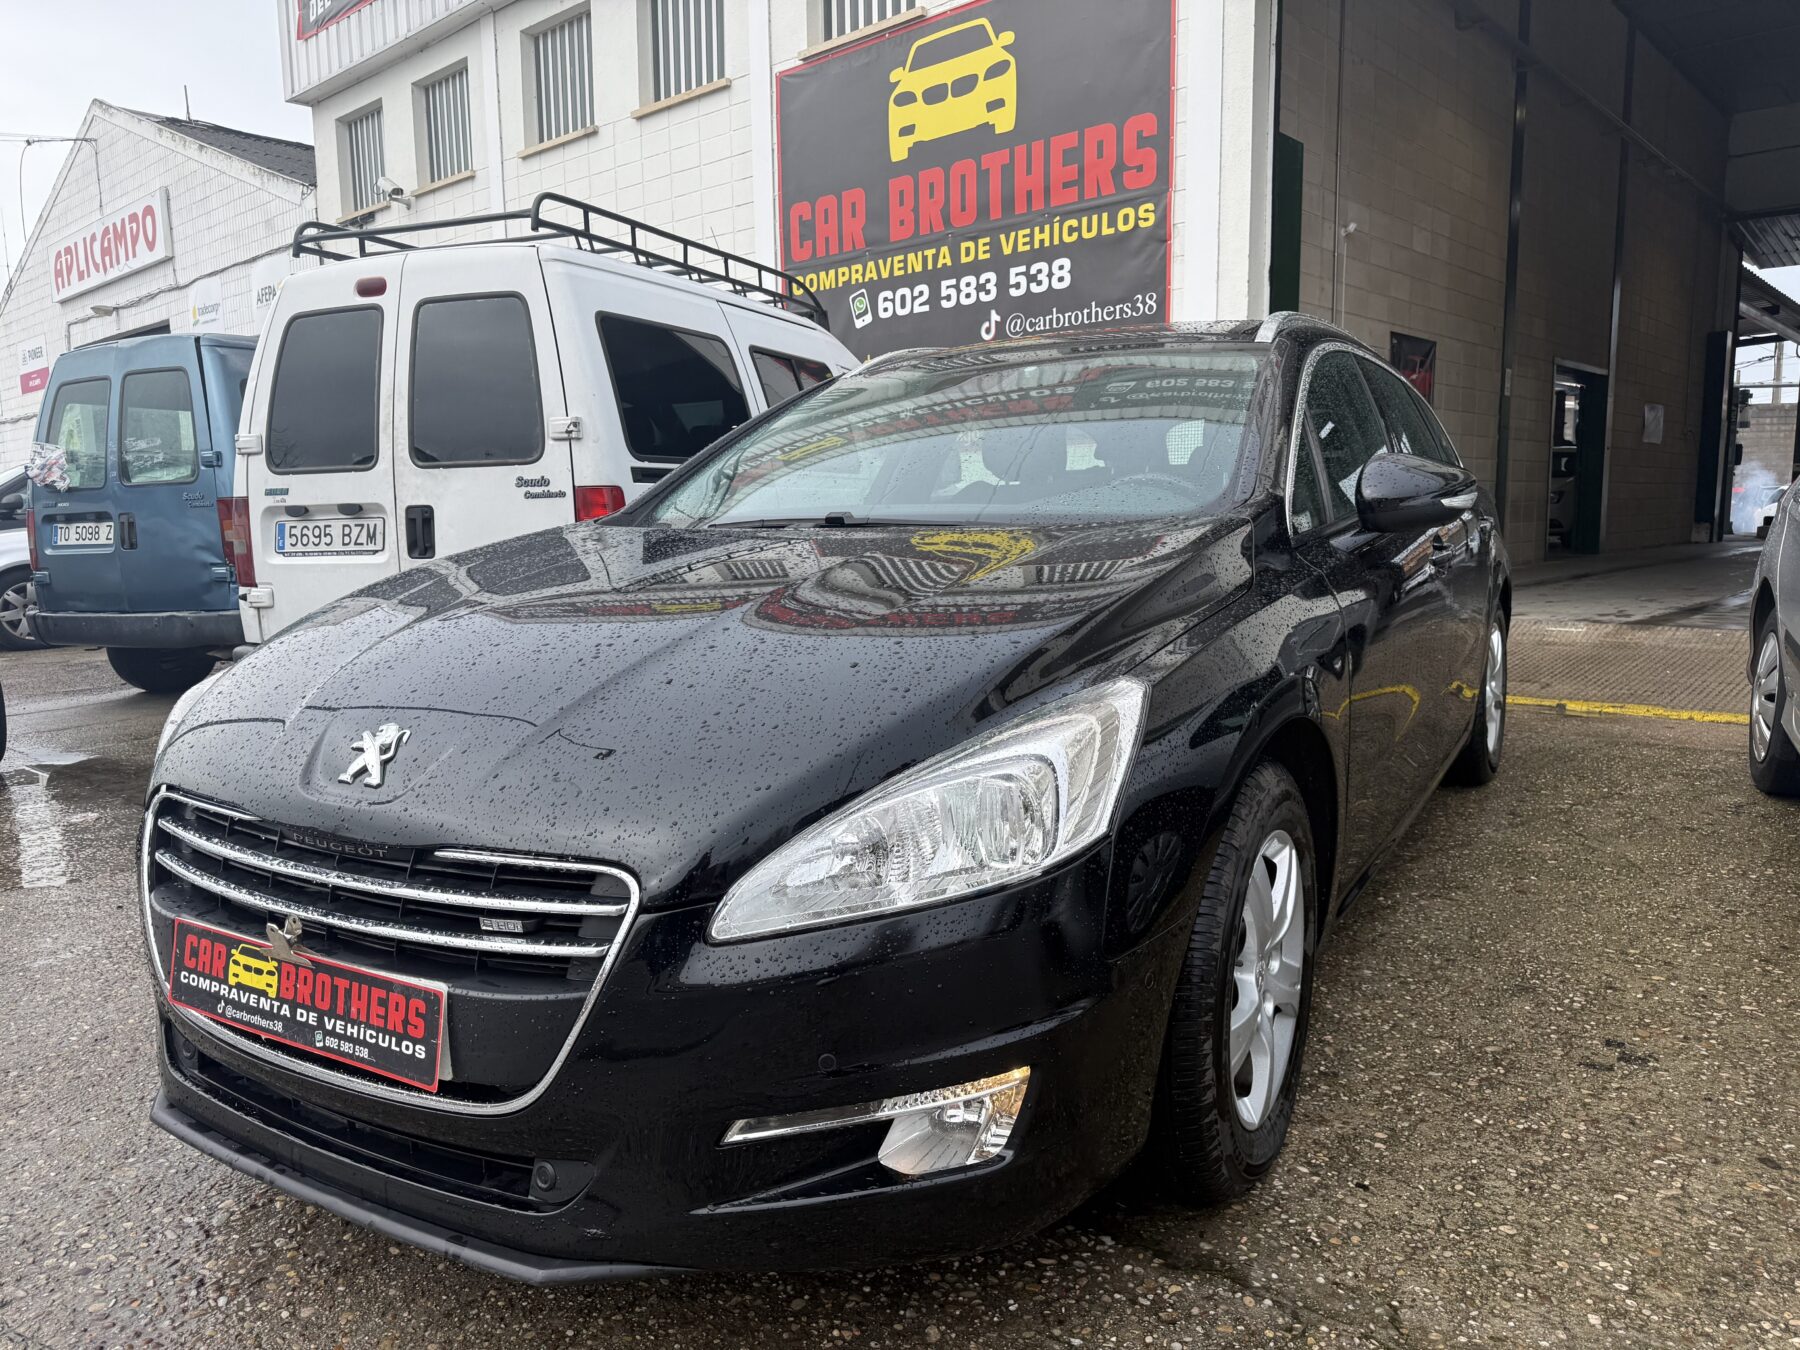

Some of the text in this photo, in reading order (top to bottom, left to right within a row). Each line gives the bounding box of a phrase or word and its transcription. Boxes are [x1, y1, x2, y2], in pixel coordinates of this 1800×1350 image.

[789, 112, 1159, 263] CAR BROTHERS
[54, 204, 157, 296] APLICAMPO
[792, 202, 1157, 296] COMPRAVENTA DE VEHÍCULOS
[877, 257, 1072, 319] 602 583 538
[1005, 292, 1158, 338] @carbrothers38
[182, 490, 204, 501] Scudo
[515, 475, 551, 488] Scudo
[524, 489, 567, 500] Combinato
[58, 524, 113, 542] TO 5098 Z
[288, 524, 334, 548] 5695
[341, 522, 377, 547] BZM
[293, 832, 388, 858] PEUGEOT
[183, 933, 426, 1039] CAR BROTHERS
[180, 971, 426, 1059] COMPRAVENTA DE VEHÍCULOS
[225, 1005, 283, 1033] @carbrothers38
[325, 1036, 369, 1059] 602 583 538
